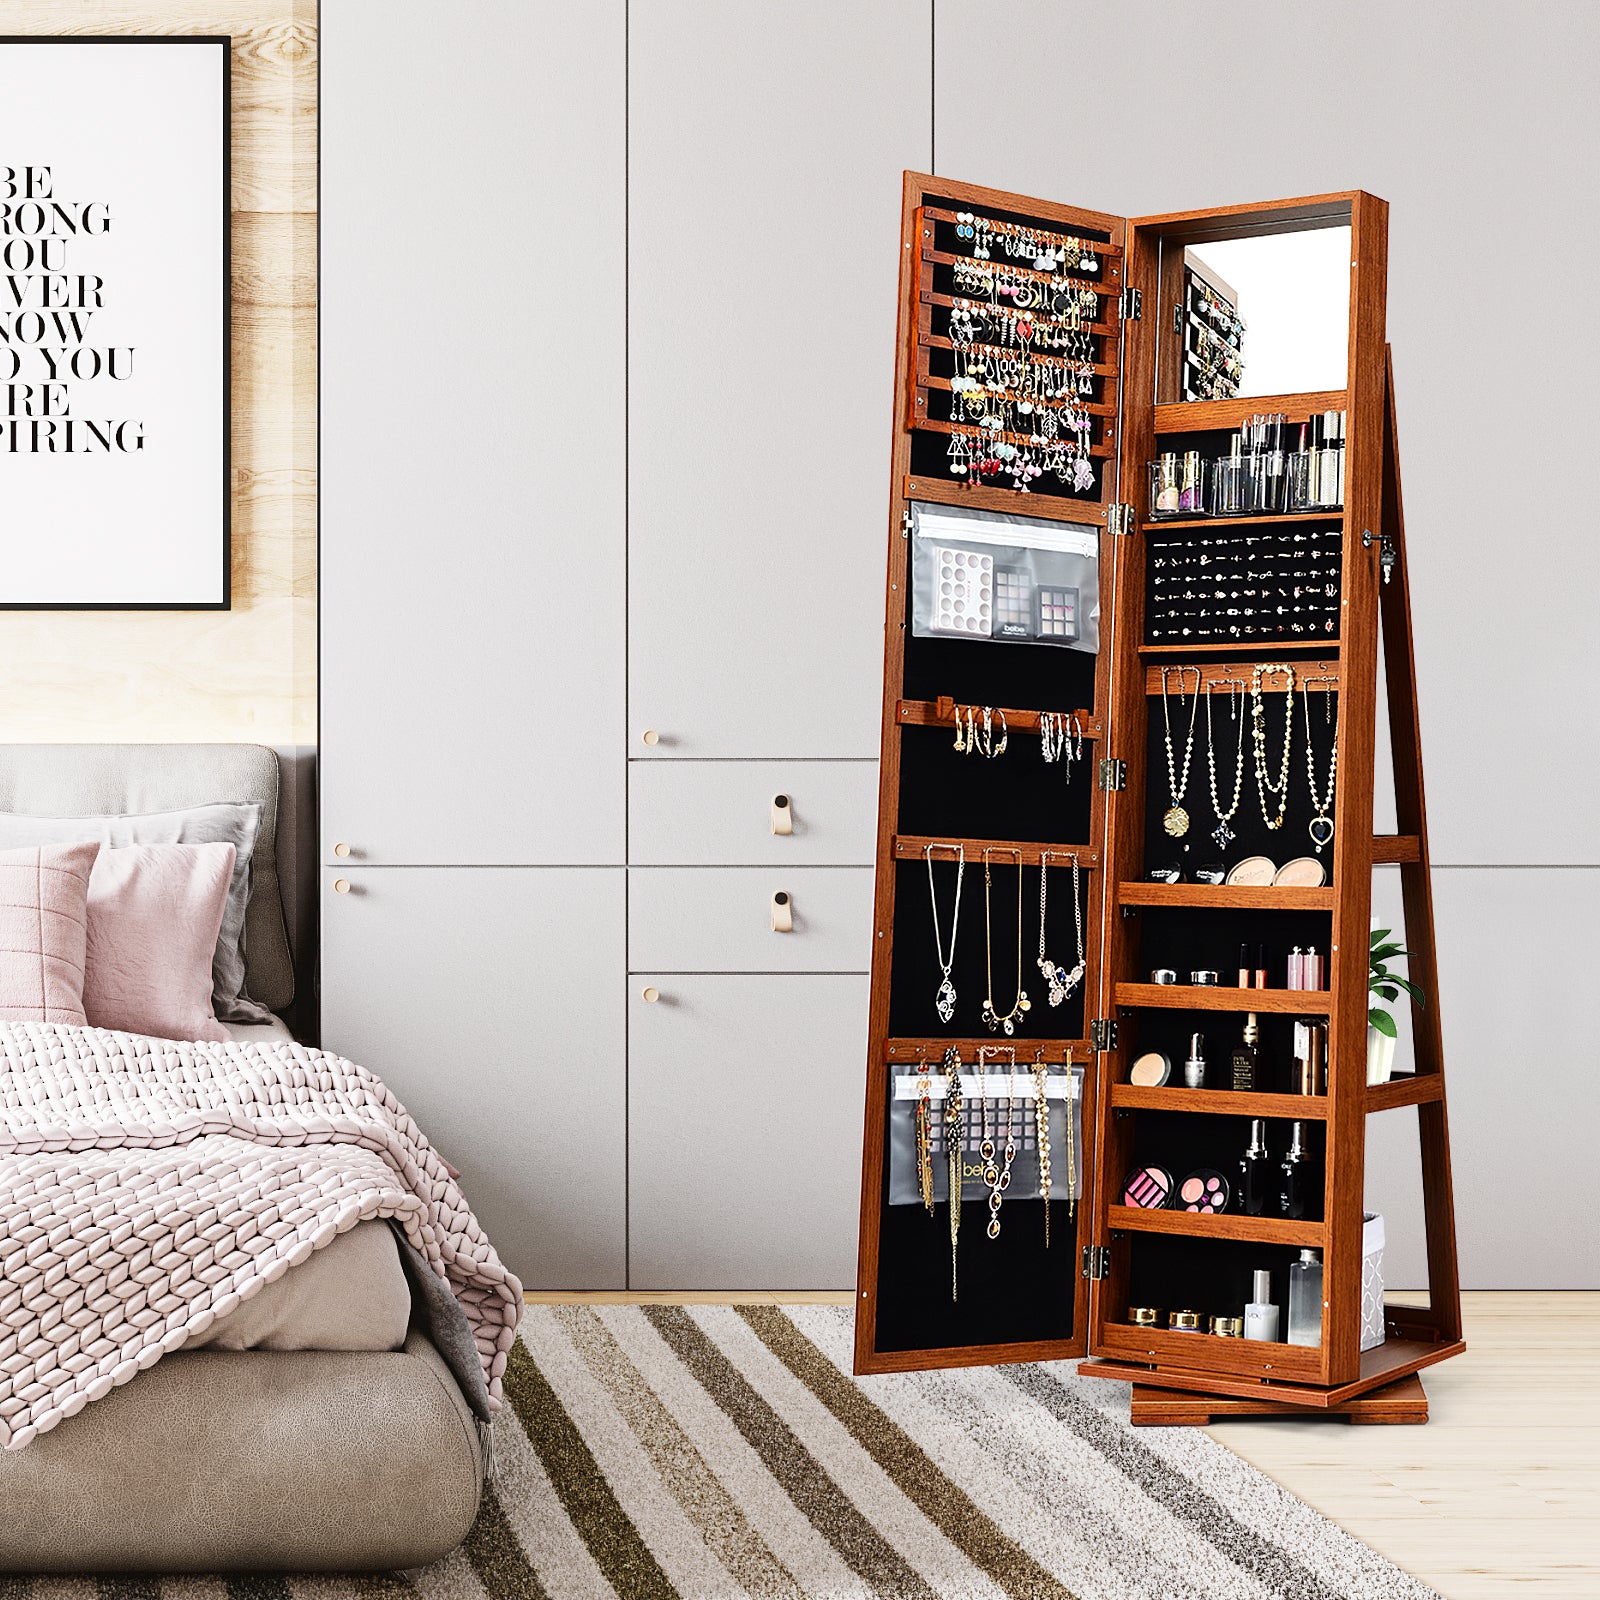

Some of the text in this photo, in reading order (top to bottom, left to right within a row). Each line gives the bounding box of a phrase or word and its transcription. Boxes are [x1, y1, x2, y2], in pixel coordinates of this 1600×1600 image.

[5, 274, 106, 308] VER
[37, 347, 136, 381] YOU
[2, 383, 70, 417] RE
[0, 419, 147, 453] IRING
